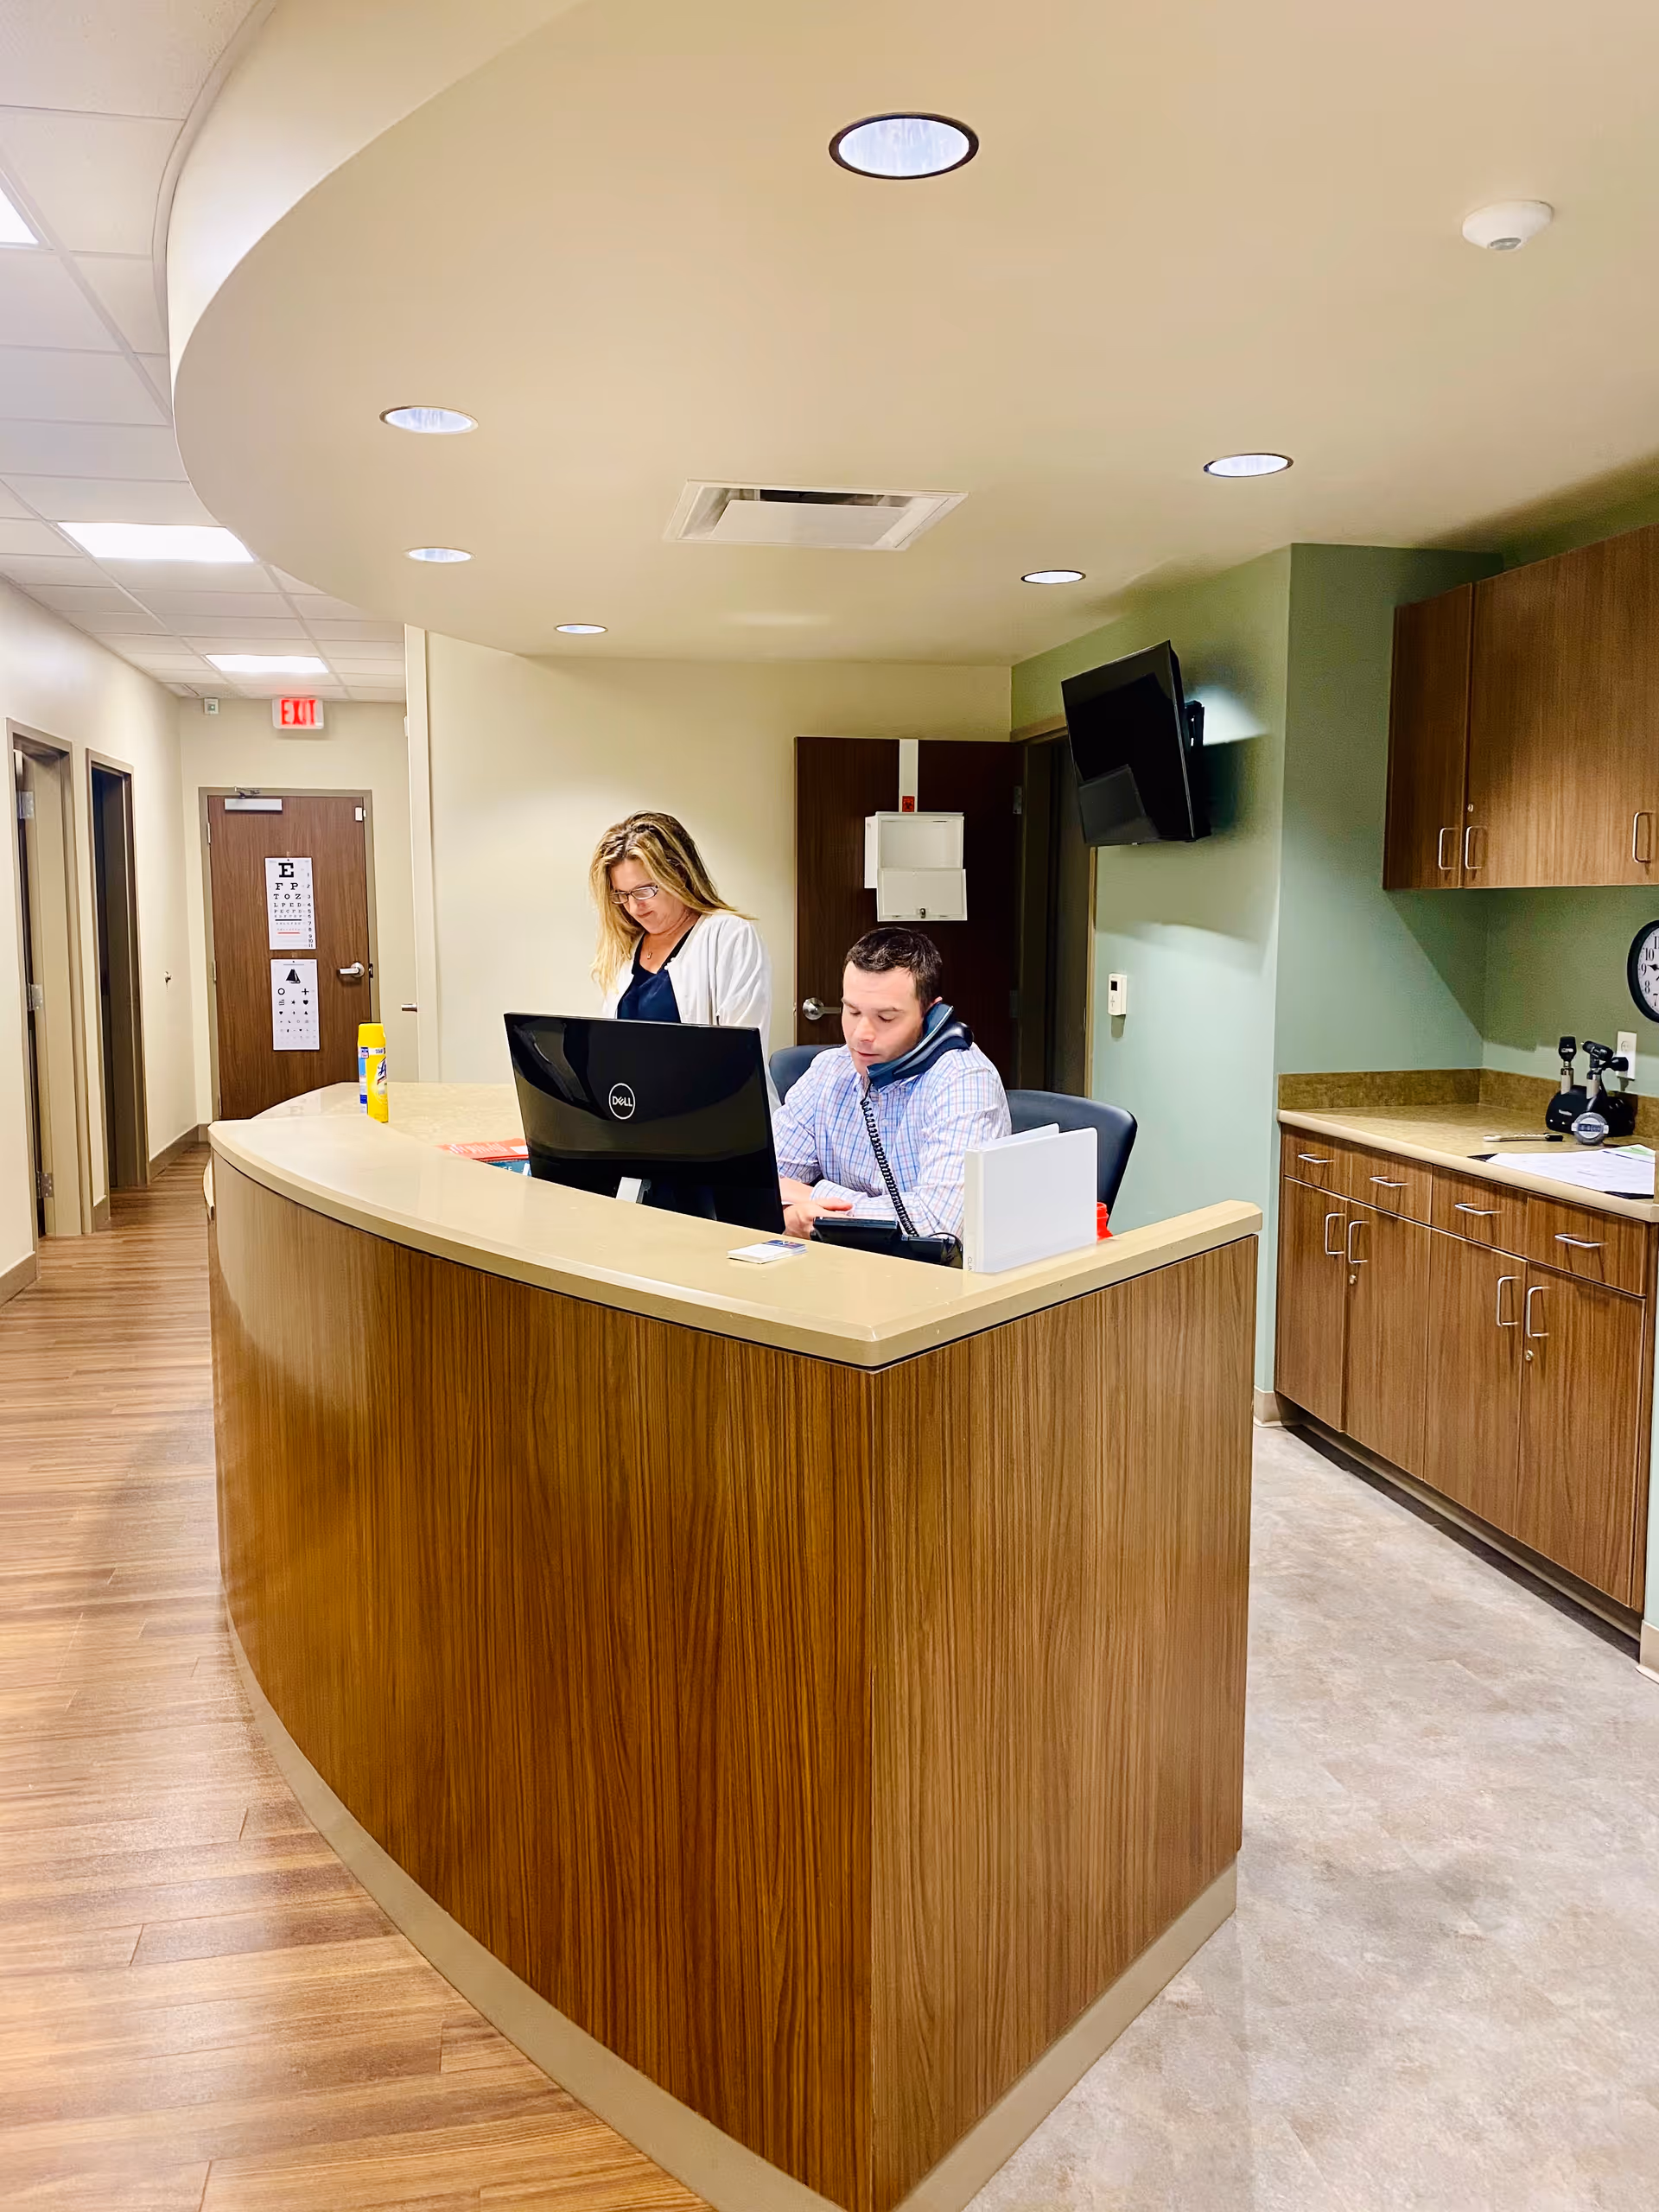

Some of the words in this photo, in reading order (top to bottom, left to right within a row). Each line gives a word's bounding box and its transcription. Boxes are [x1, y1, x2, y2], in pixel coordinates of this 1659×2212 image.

[281, 699, 316, 726] EXIT
[278, 862, 294, 878] E
[1645, 947, 1655, 961] 10
[1641, 963, 1647, 976] 9
[1644, 980, 1650, 994] 8
[1652, 993, 1658, 1006] 7
[612, 1096, 633, 1107] DELL
